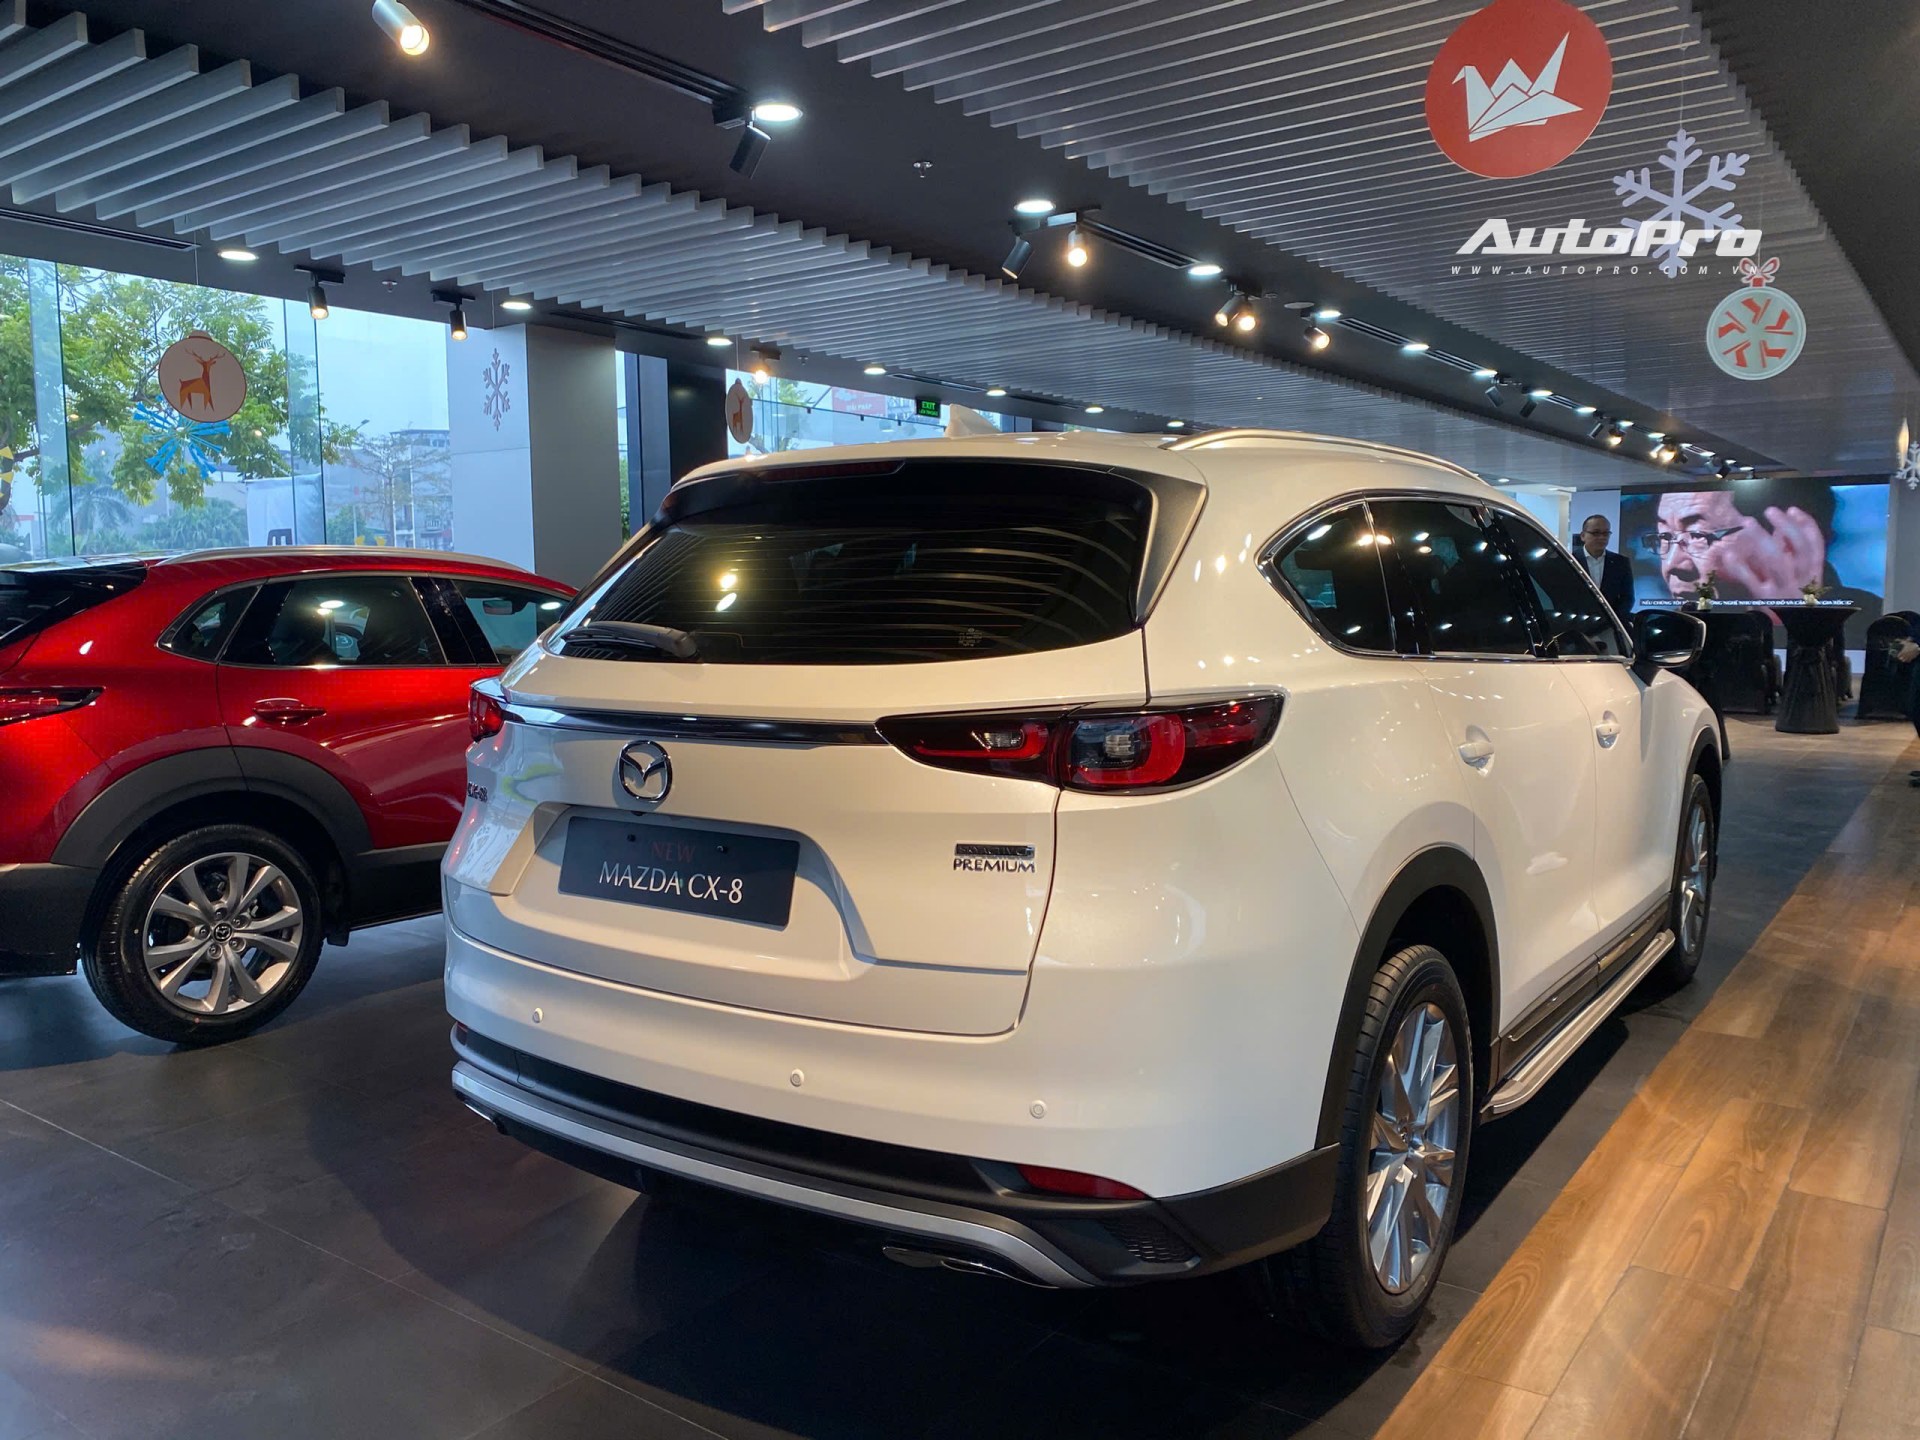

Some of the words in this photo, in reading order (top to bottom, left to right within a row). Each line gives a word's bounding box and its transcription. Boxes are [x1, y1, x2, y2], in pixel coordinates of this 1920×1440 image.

[921, 401, 935, 410] EXIT
[652, 840, 696, 863] NEW
[953, 858, 1035, 873] PREMIUM
[599, 861, 681, 896] MAZDA
[688, 873, 743, 904] CX-8
